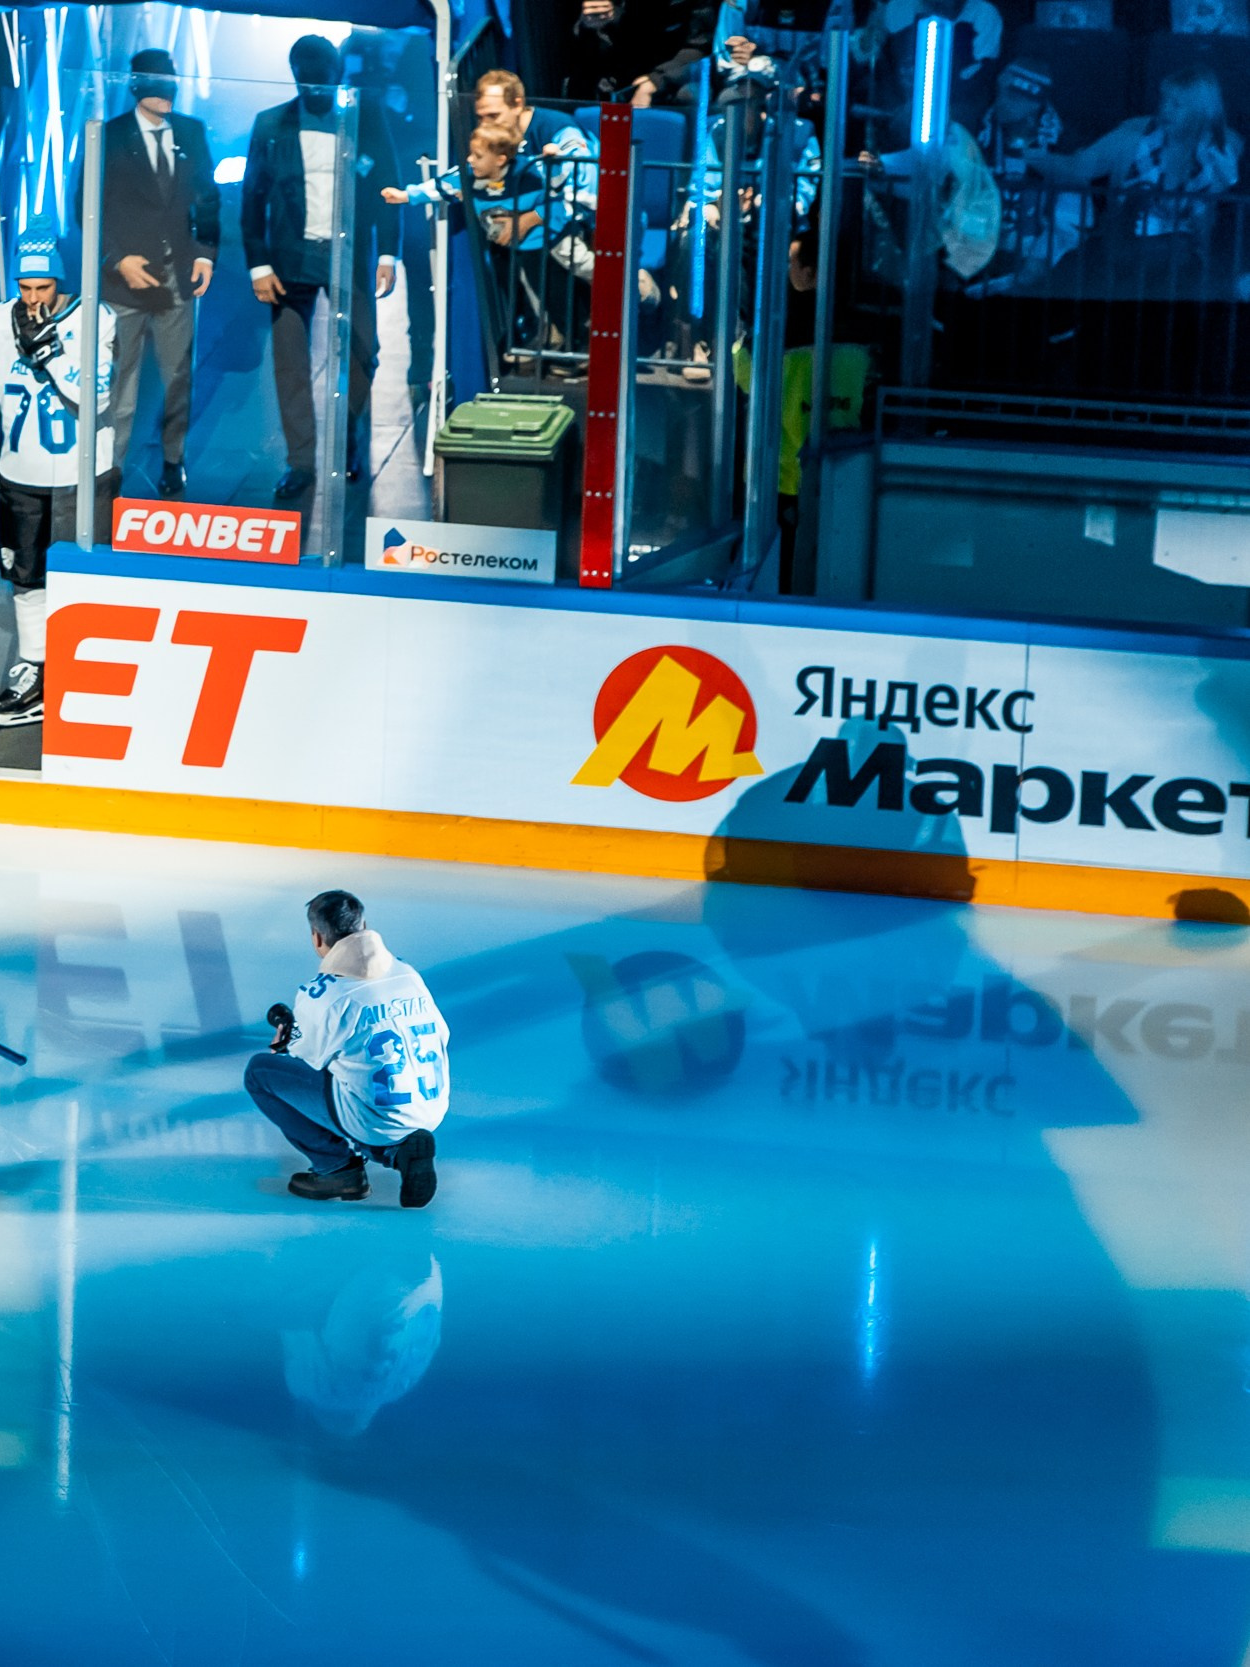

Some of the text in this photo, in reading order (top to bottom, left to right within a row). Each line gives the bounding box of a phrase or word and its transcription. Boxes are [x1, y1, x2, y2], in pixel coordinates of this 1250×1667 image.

[116, 509, 297, 554] FONBET
[410, 545, 538, 571] Ростелеком
[794, 666, 1036, 734] Яндекс
[367, 1021, 446, 1106] 25
